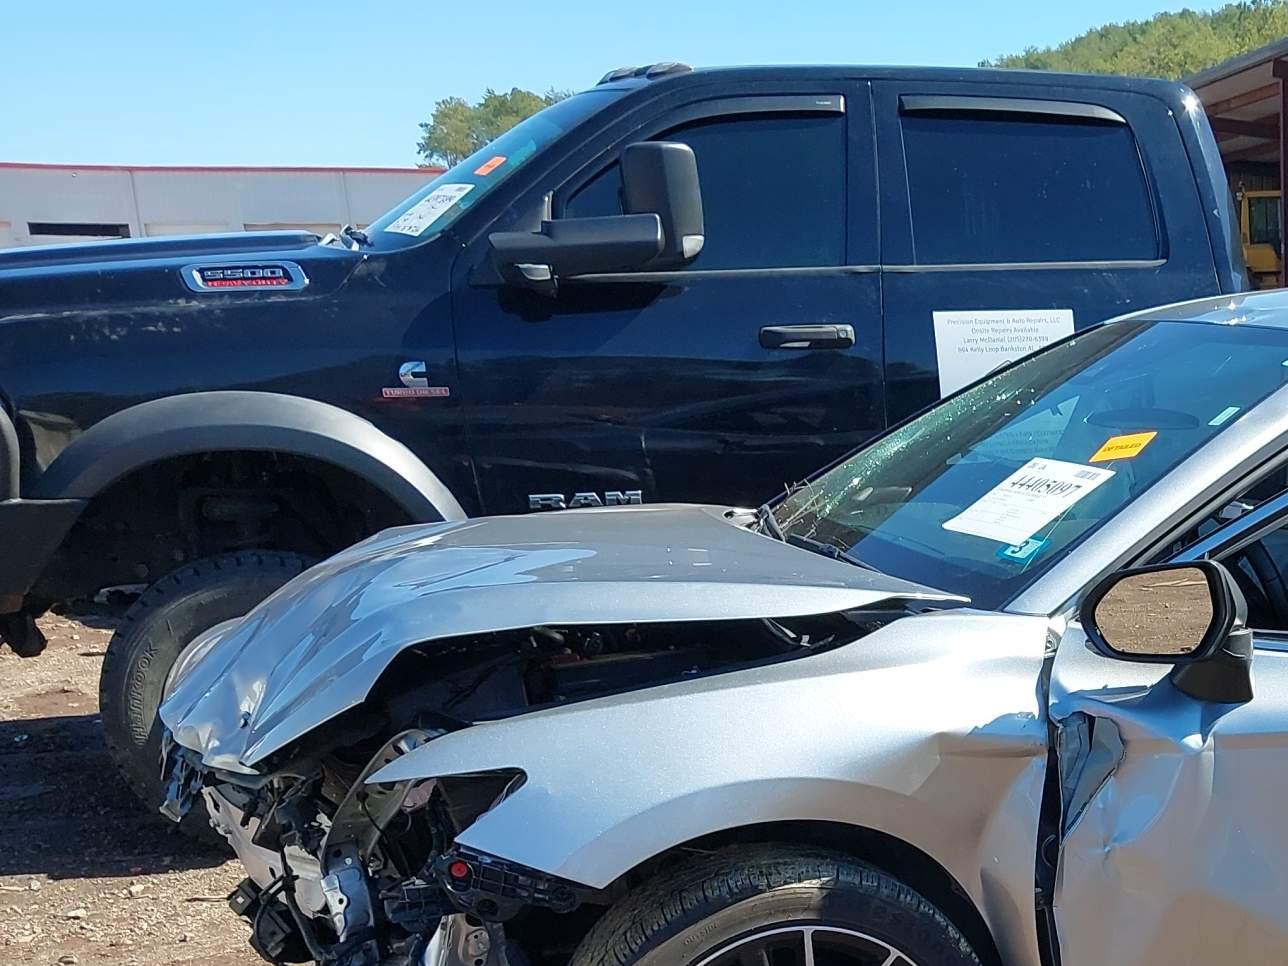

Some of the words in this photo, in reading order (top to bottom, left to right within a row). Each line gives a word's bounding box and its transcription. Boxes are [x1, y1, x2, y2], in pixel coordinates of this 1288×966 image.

[203, 268, 284, 279] 5500
[974, 318, 1005, 326] Equipment
[1050, 316, 1061, 324] LLC
[971, 327, 989, 335] Onsite
[991, 327, 1012, 335] Repairs
[1013, 326, 1039, 334] Available
[963, 337, 979, 345] Larry
[980, 336, 1005, 344] McDaniel
[985, 346, 999, 354] Loop
[1001, 345, 1027, 353] Bankston
[1103, 442, 1142, 453] DETAILED
[1010, 475, 1083, 498] 44405097
[528, 489, 643, 509] RAM
